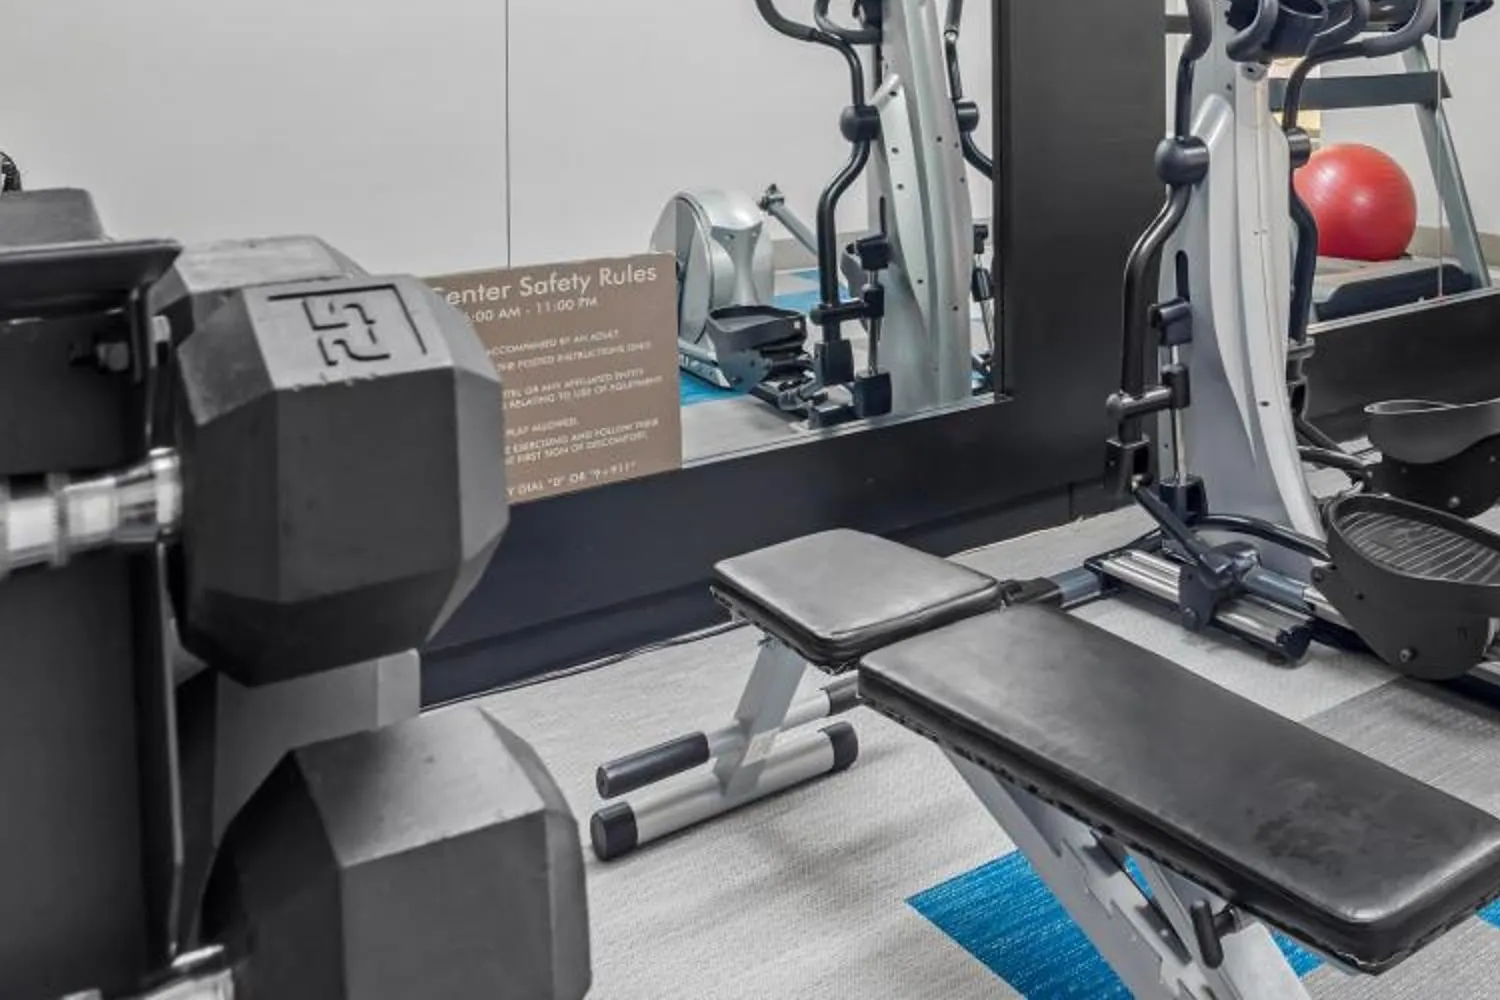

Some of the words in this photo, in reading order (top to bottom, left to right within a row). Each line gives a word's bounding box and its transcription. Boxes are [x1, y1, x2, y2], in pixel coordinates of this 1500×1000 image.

[432, 284, 512, 305] enter
[519, 271, 591, 297] Safety
[599, 263, 657, 287] Rules
[499, 307, 521, 319] AM
[536, 299, 575, 314] 11:00
